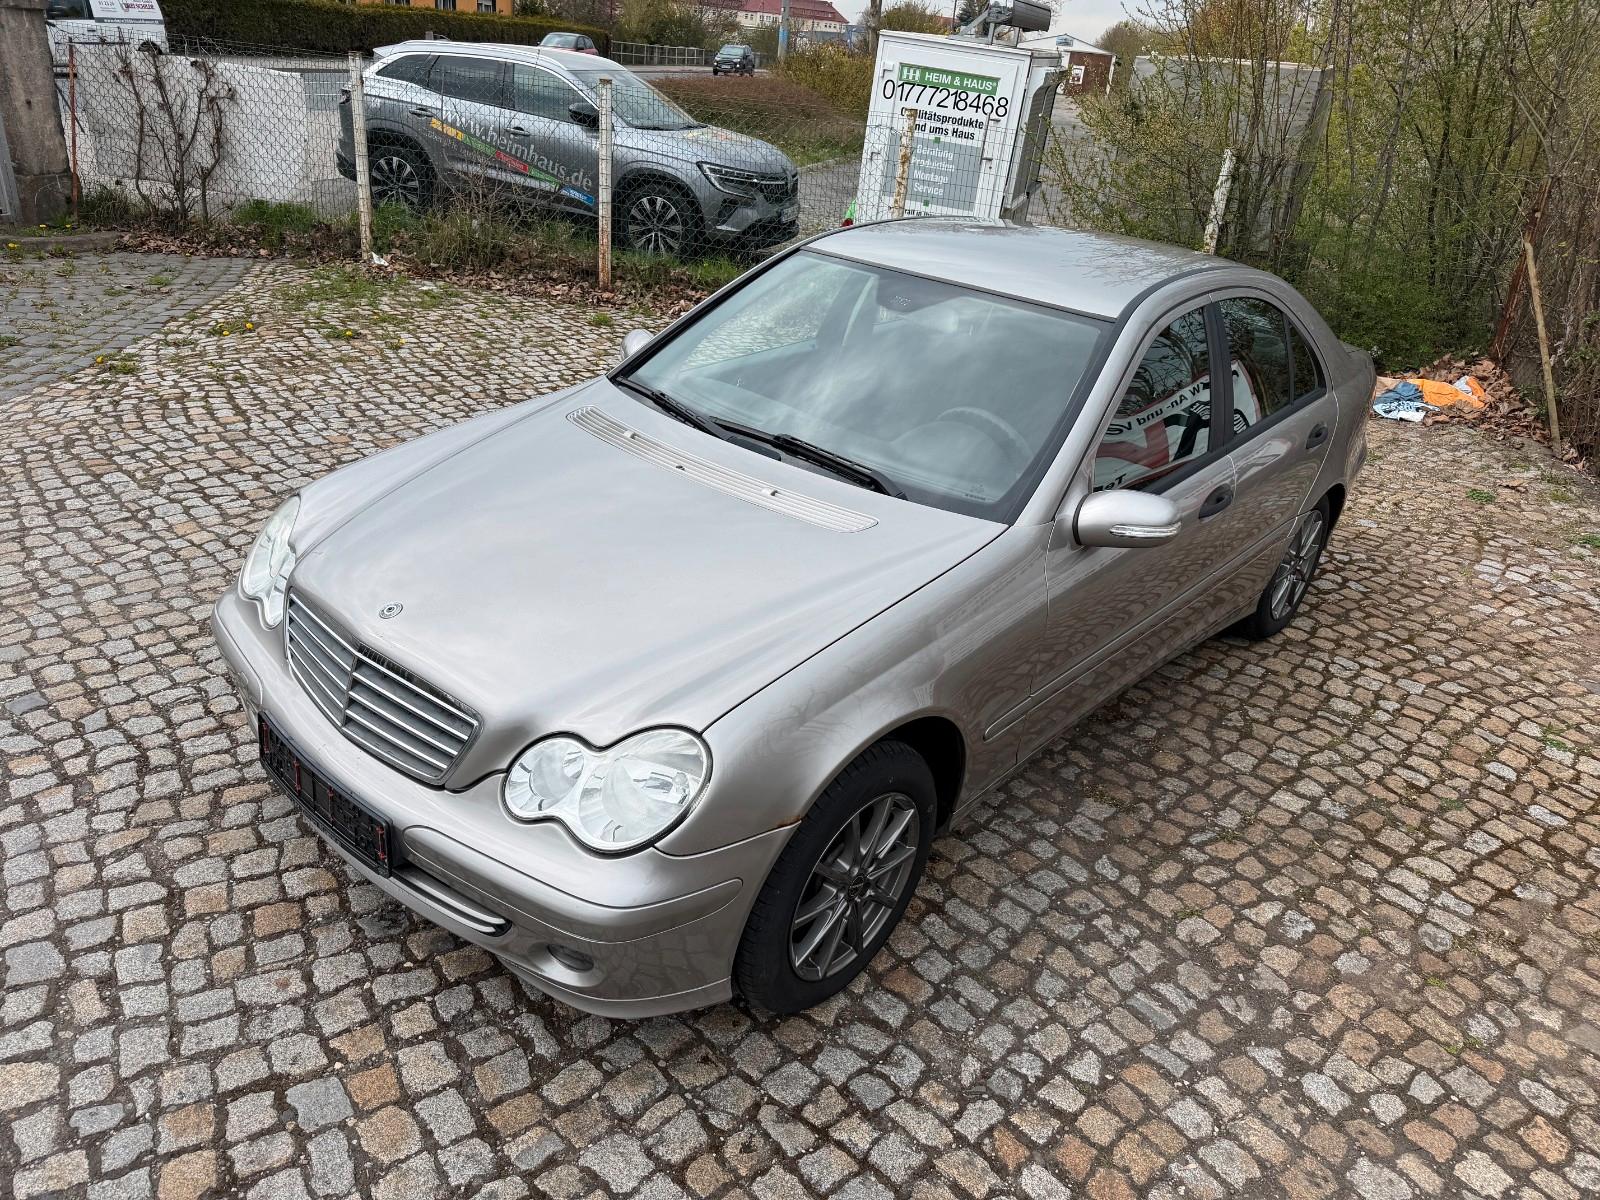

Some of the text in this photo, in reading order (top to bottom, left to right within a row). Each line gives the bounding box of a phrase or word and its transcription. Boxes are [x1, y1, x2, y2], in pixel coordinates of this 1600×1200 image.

[925, 72, 951, 85] HEIM
[953, 76, 961, 86] &
[883, 80, 1009, 117] 01777218468
[901, 107, 984, 129] Qlitätsprodukte
[929, 125, 949, 136] ums
[952, 128, 975, 140] Haus
[916, 145, 954, 160] Beratung
[913, 170, 949, 185] Montage
[913, 183, 944, 196] Service
